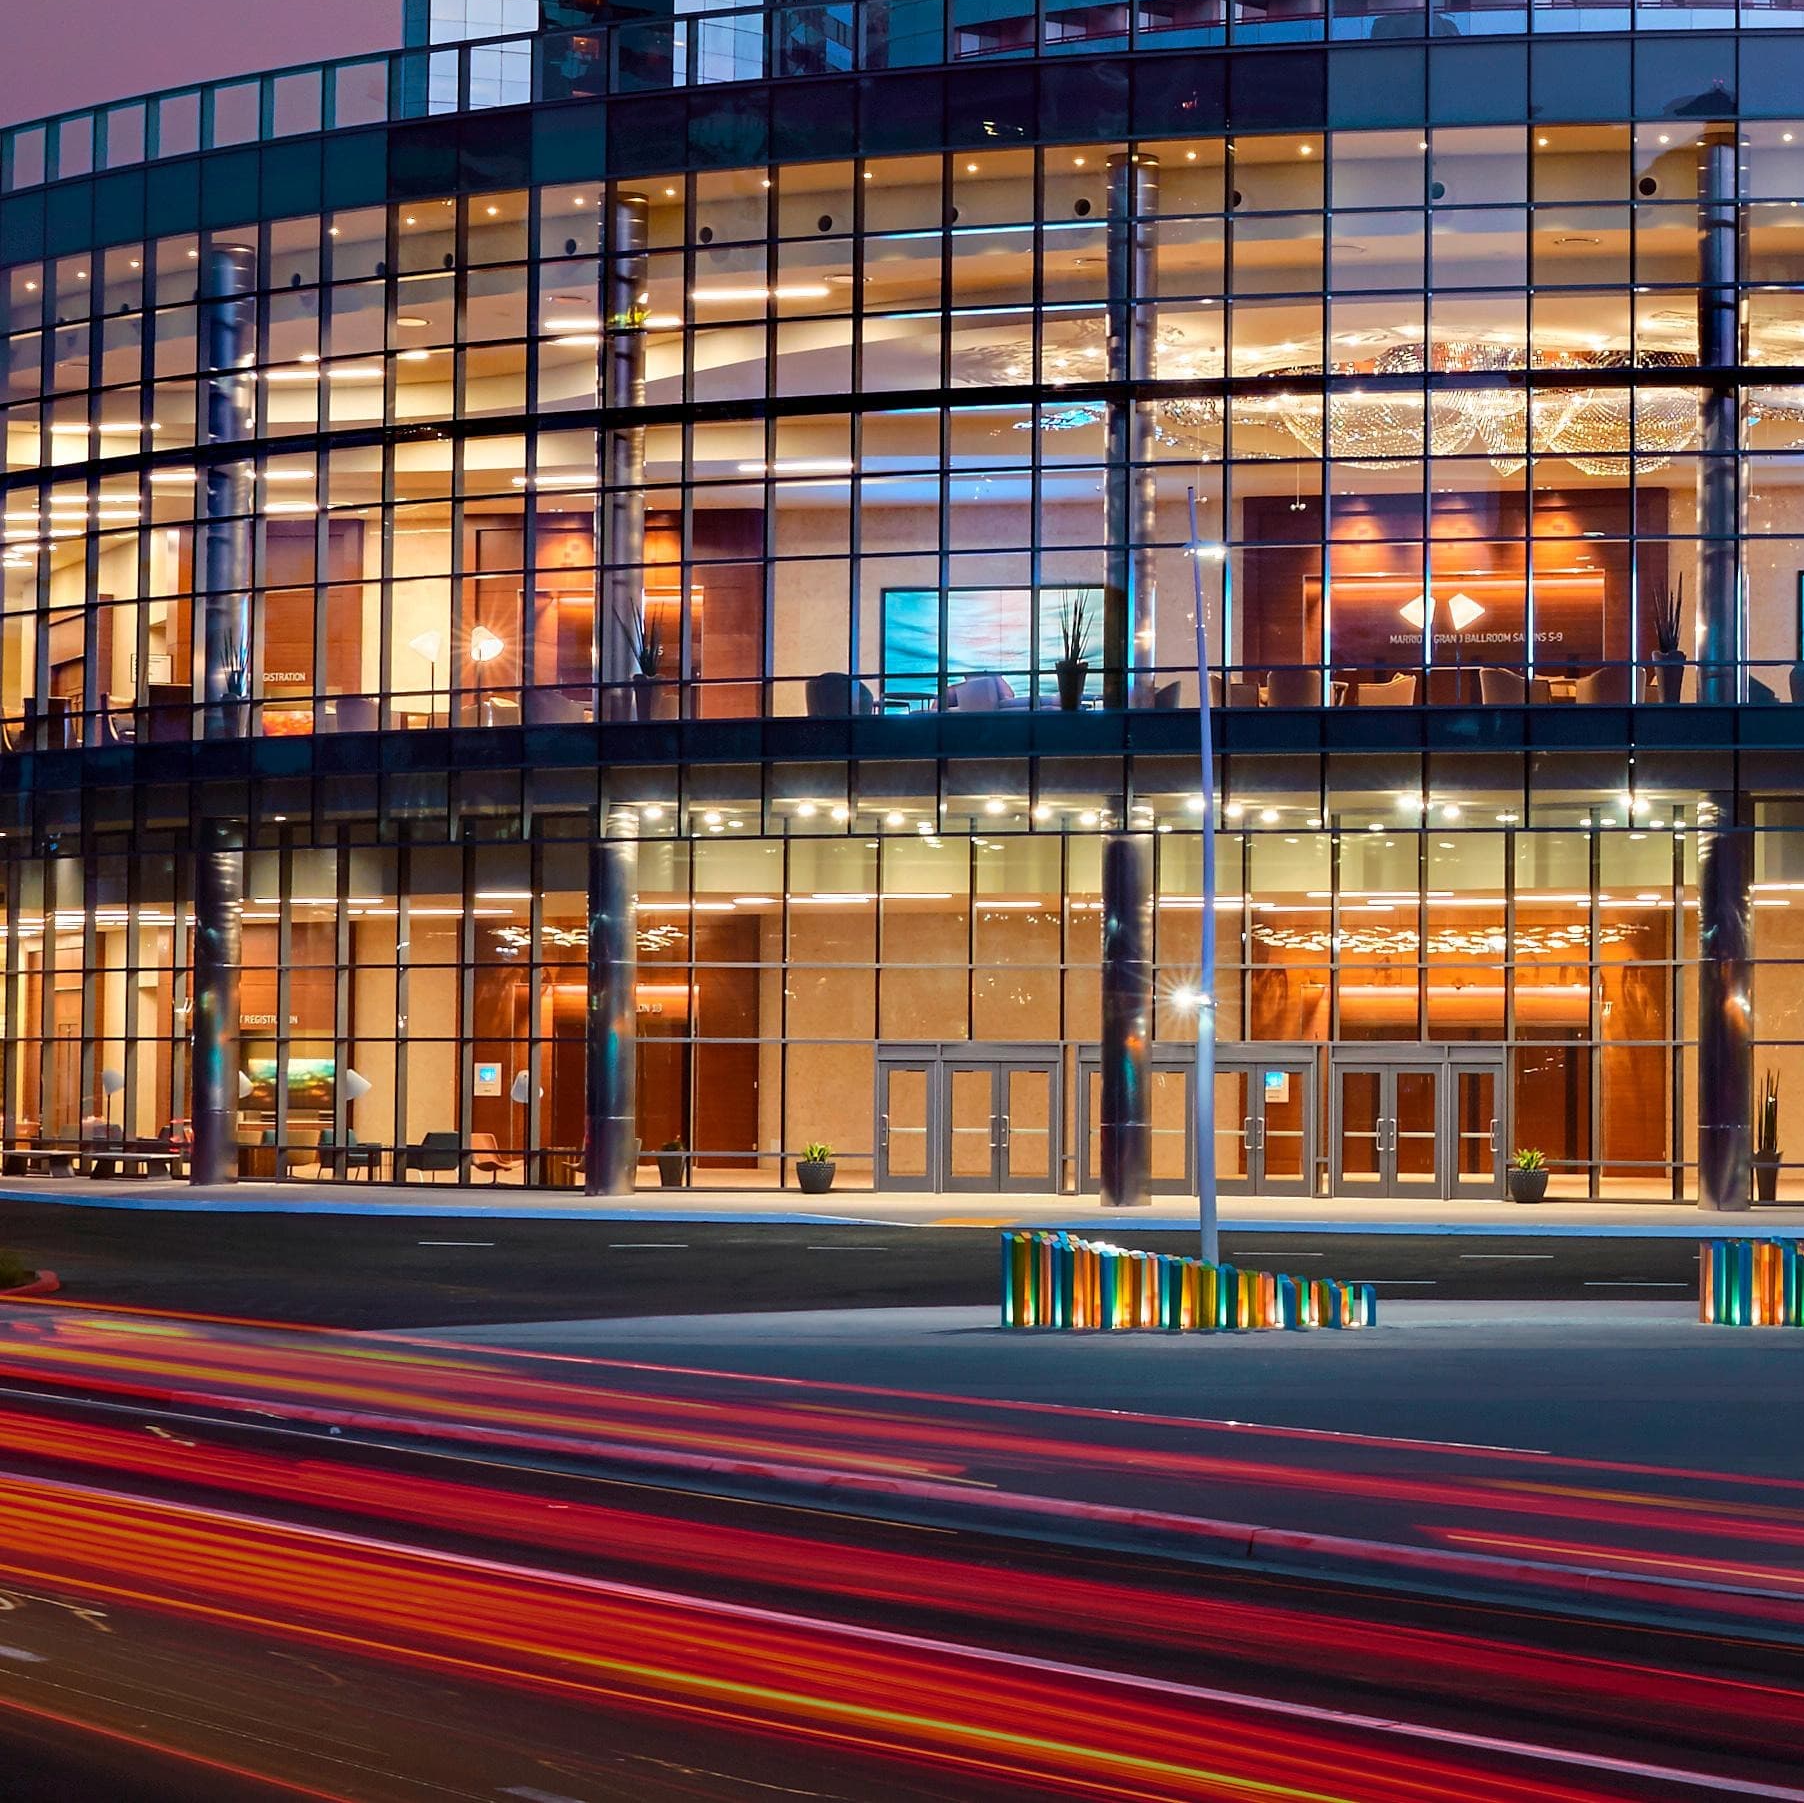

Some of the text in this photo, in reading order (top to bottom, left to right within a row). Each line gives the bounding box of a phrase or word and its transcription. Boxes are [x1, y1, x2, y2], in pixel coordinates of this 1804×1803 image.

[1389, 634, 1424, 644] MARRIO
[1464, 632, 1511, 643] BALLROOM
[1512, 631, 1547, 643] SANS
